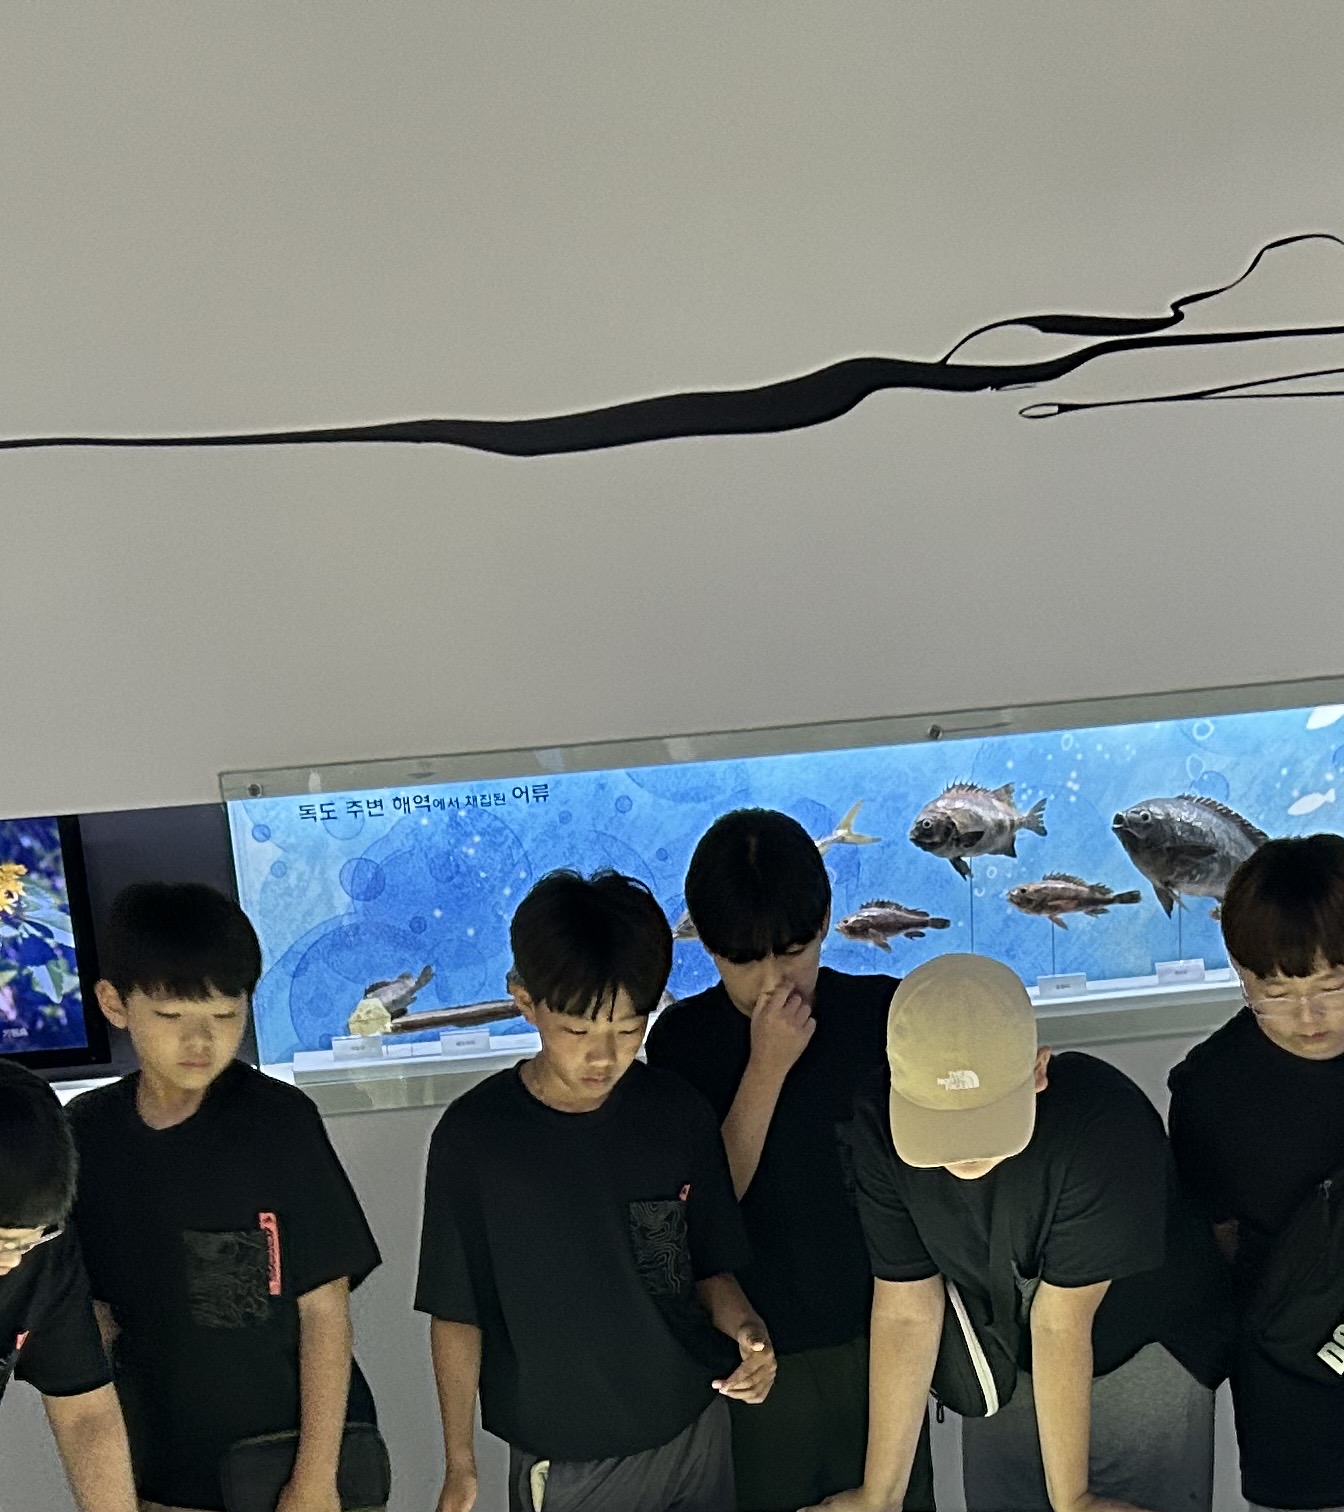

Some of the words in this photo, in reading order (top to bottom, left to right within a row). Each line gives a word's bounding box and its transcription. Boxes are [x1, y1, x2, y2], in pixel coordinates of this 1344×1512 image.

[299, 802, 338, 823] 독도
[346, 799, 384, 819] 주변
[392, 794, 460, 815] 해역에서
[465, 793, 507, 808] 채집된
[512, 783, 549, 804] 어류
